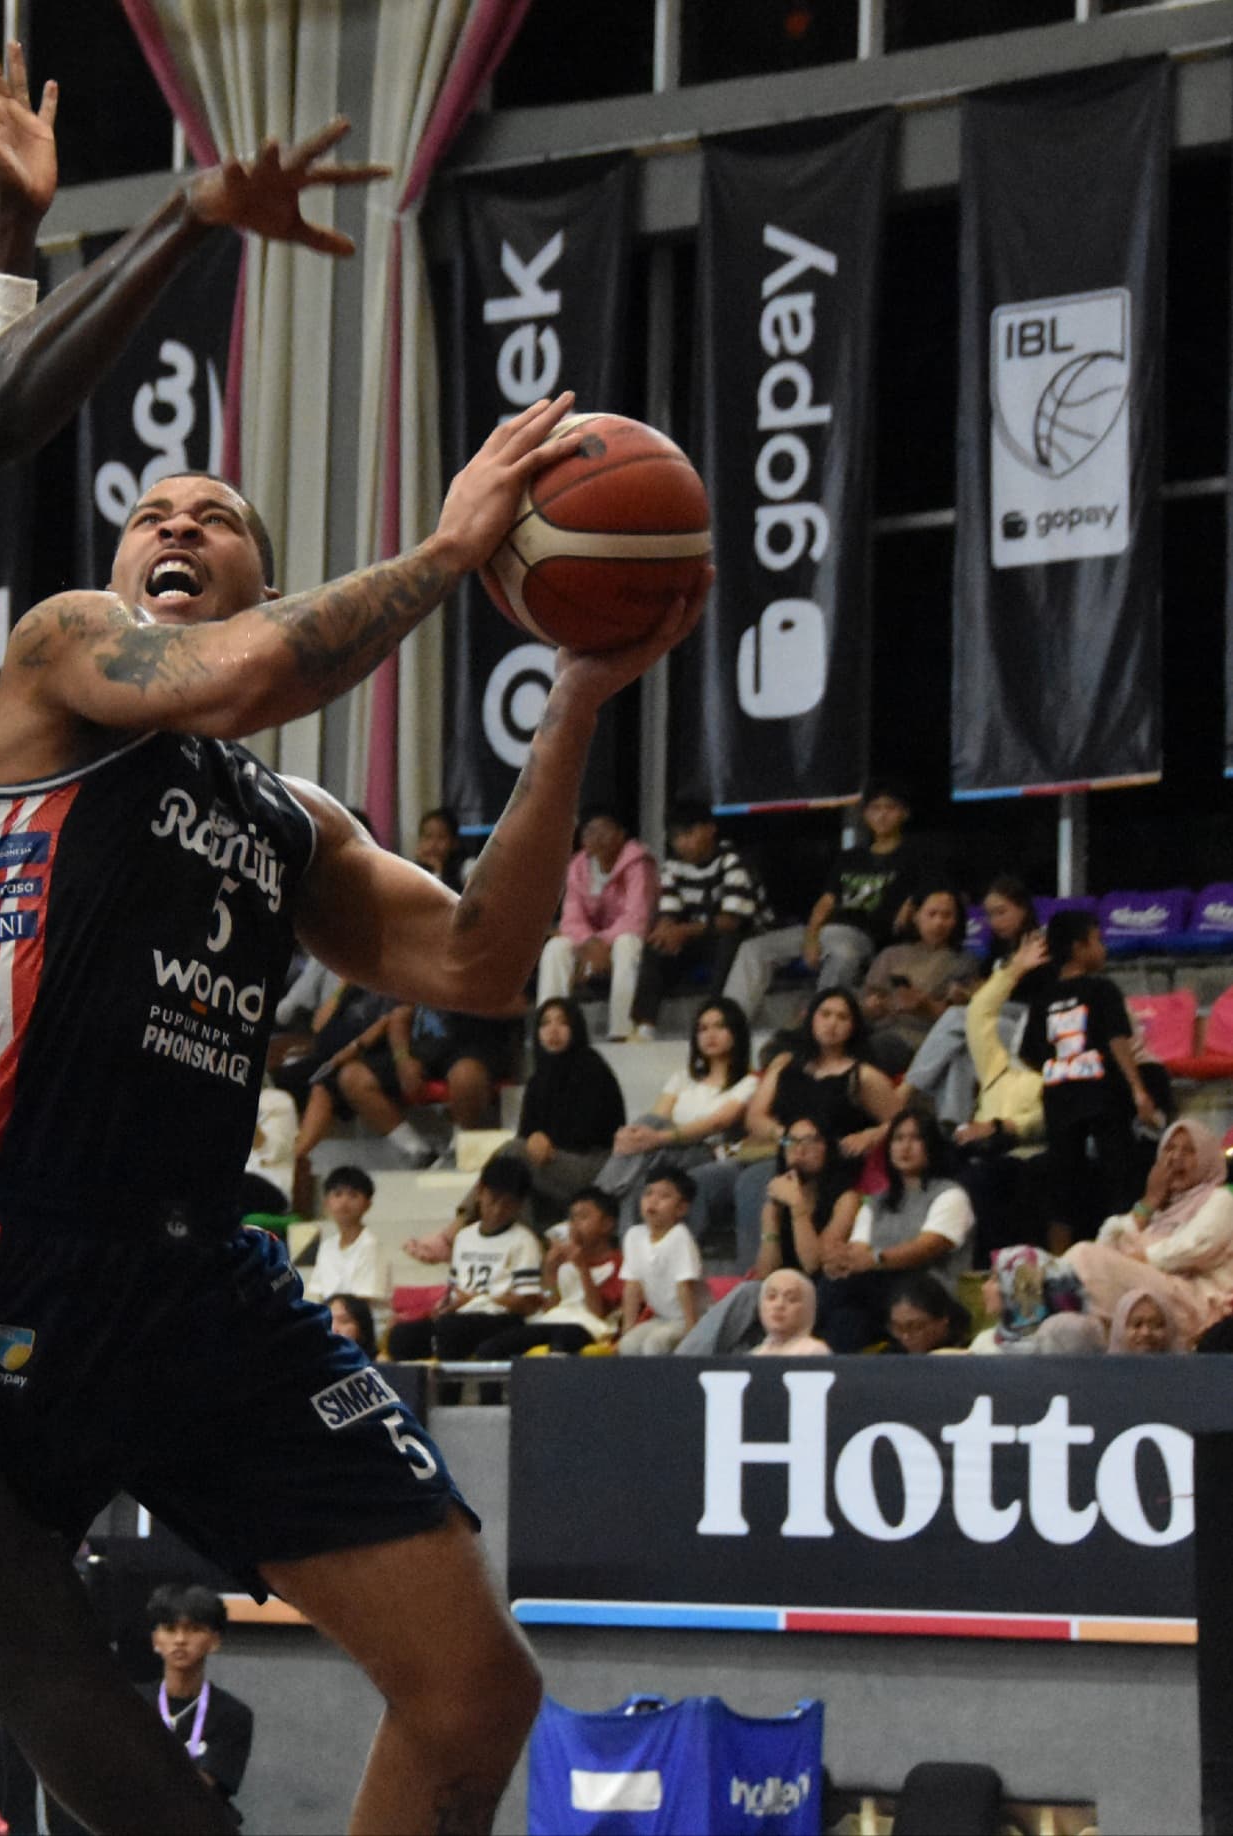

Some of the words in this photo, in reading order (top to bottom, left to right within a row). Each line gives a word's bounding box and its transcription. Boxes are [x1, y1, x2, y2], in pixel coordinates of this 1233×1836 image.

[483, 230, 563, 407] ek
[1006, 316, 1074, 359] IBL
[755, 224, 838, 571] gopay
[1036, 505, 1119, 539] gopay
[206, 875, 242, 953] 5
[149, 1004, 199, 1034] PUPUK
[201, 1025, 230, 1046] NPK
[317, 1371, 391, 1427] SIMPA
[382, 1408, 438, 1481] 5
[696, 1370, 1195, 1548] Hotto
